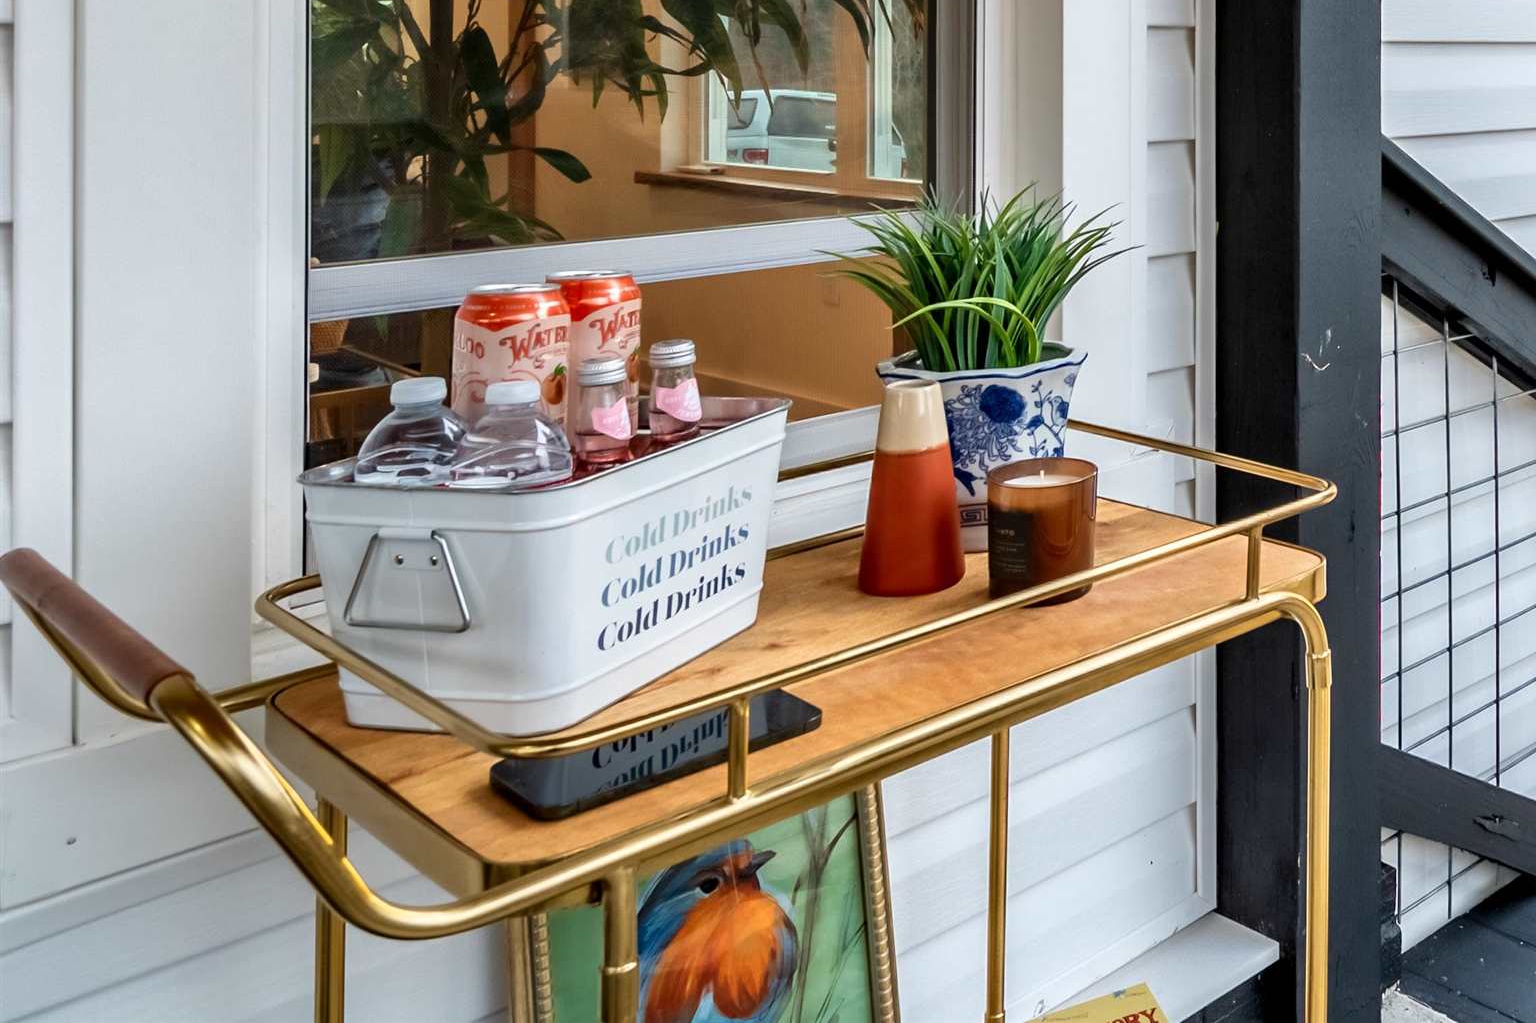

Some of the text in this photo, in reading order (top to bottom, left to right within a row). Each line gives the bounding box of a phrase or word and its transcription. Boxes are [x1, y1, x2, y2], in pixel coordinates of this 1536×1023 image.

[601, 523, 749, 608] Cold Drinks
[605, 484, 752, 565] Cold Drinks
[597, 562, 746, 651] Cold Drinks
